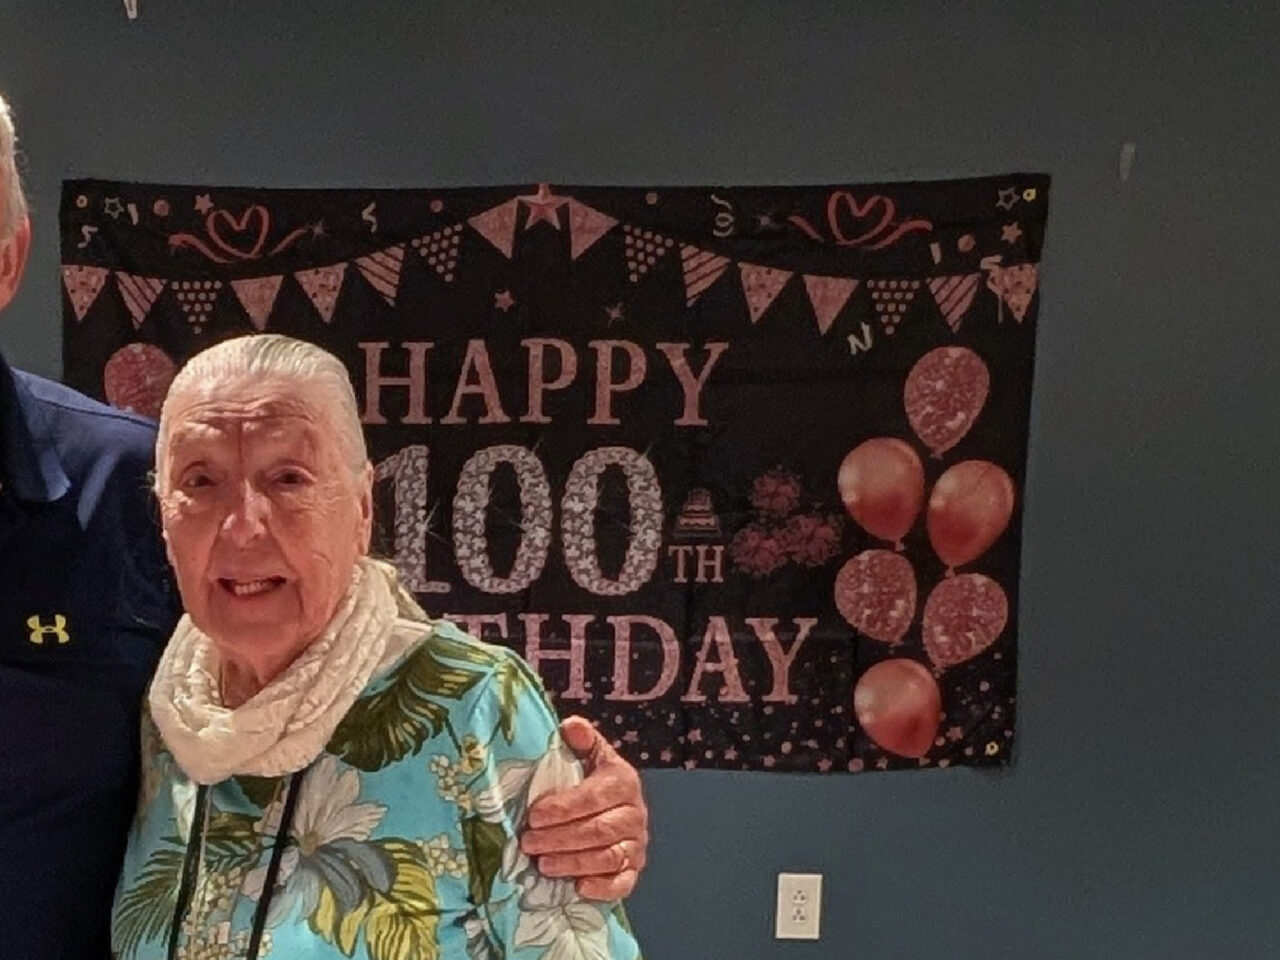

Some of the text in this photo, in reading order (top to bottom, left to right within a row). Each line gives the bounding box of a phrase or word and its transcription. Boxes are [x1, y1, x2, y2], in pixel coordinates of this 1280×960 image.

[357, 337, 730, 427] HAPPY
[374, 443, 725, 596] 100 TH
[442, 612, 818, 702] THDAY
